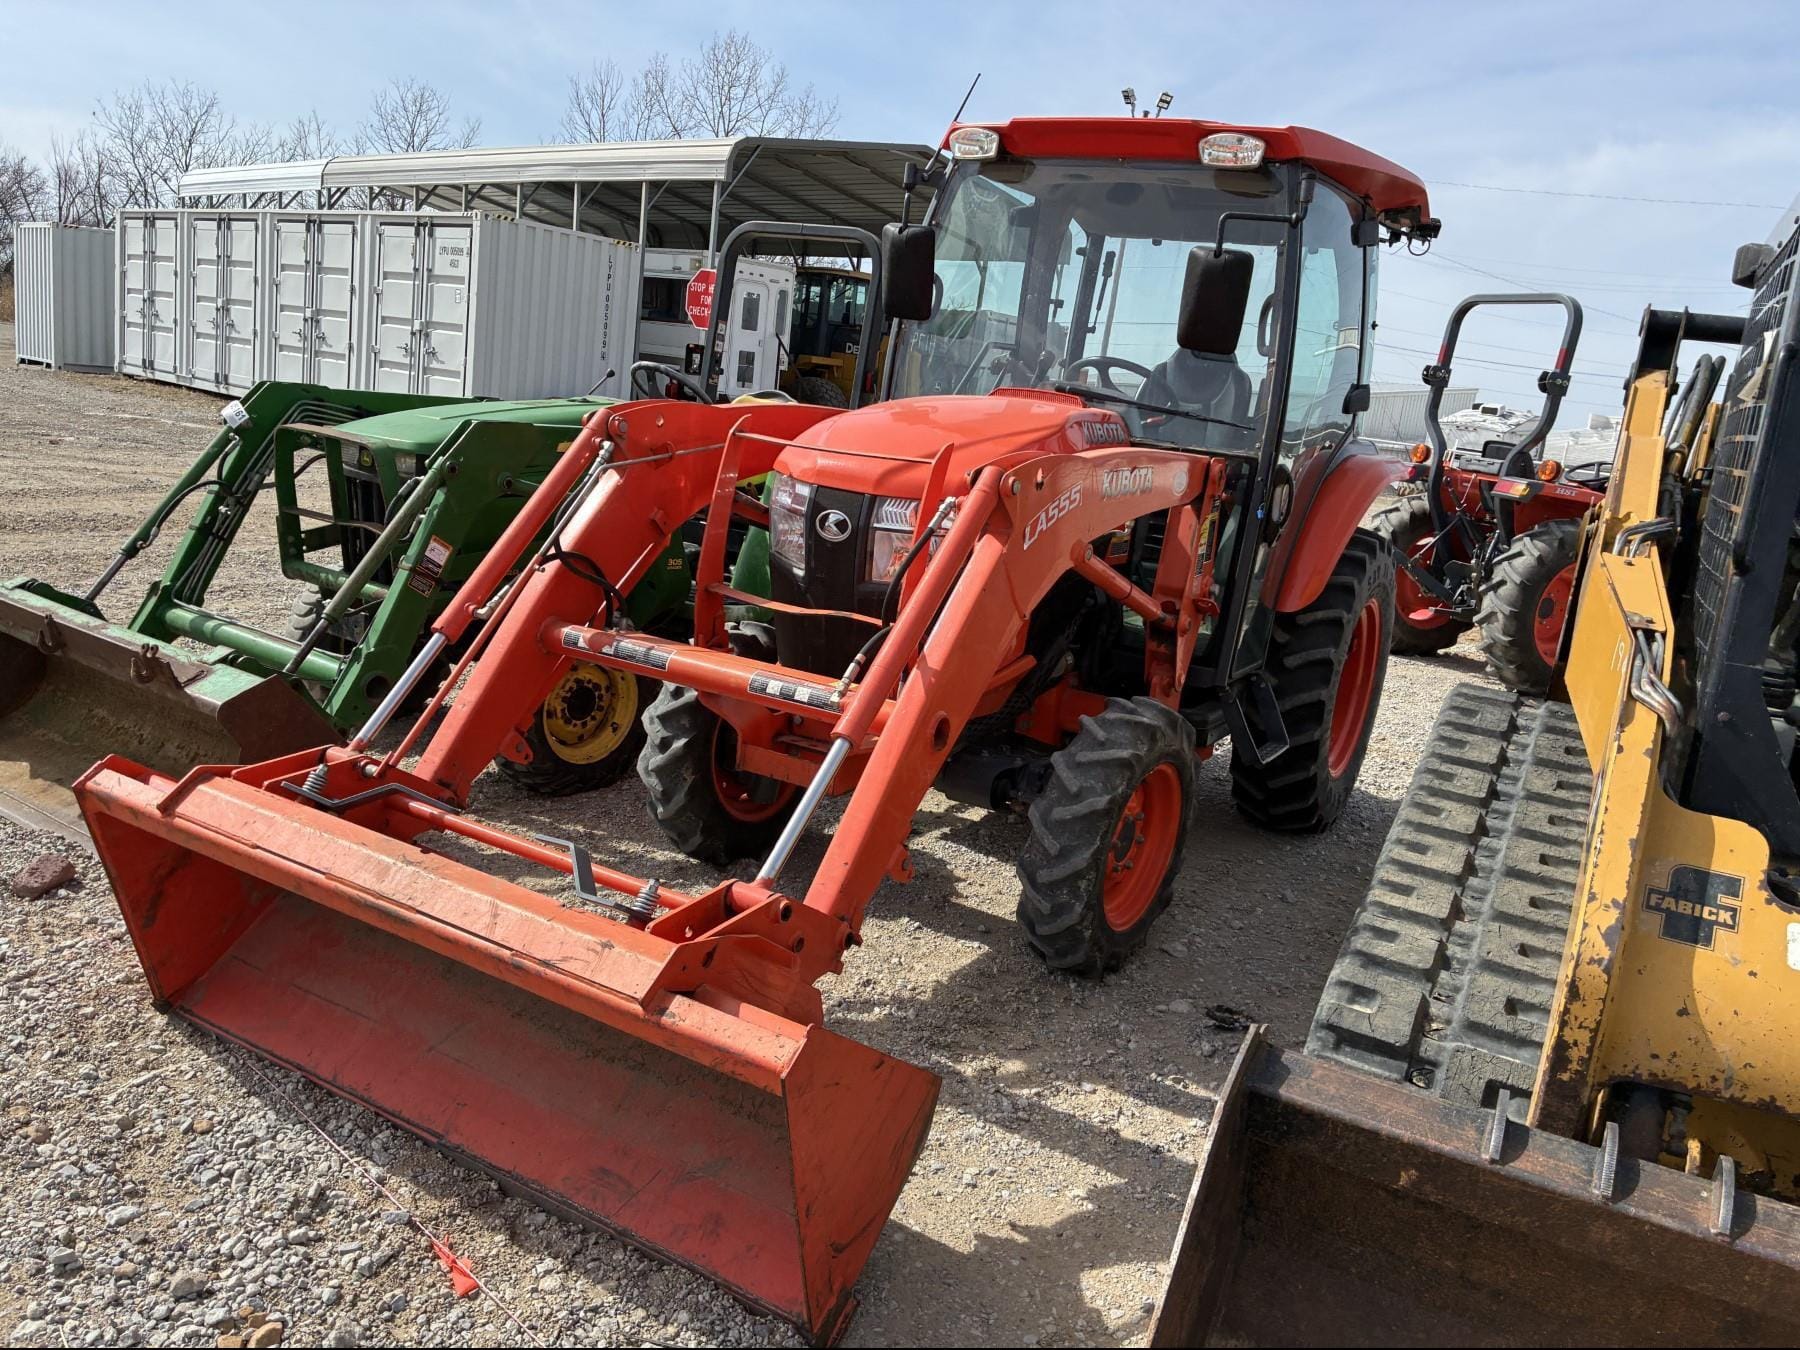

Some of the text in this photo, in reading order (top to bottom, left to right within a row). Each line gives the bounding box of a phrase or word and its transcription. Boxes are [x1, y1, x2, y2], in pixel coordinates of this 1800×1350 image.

[690, 282, 706, 292] STOP
[688, 305, 711, 316] CHECK-
[1081, 420, 1125, 445] KUBOTA
[1102, 466, 1153, 498] KUBOTA
[1023, 482, 1083, 551] LA555
[1648, 892, 1734, 926] FABICK
